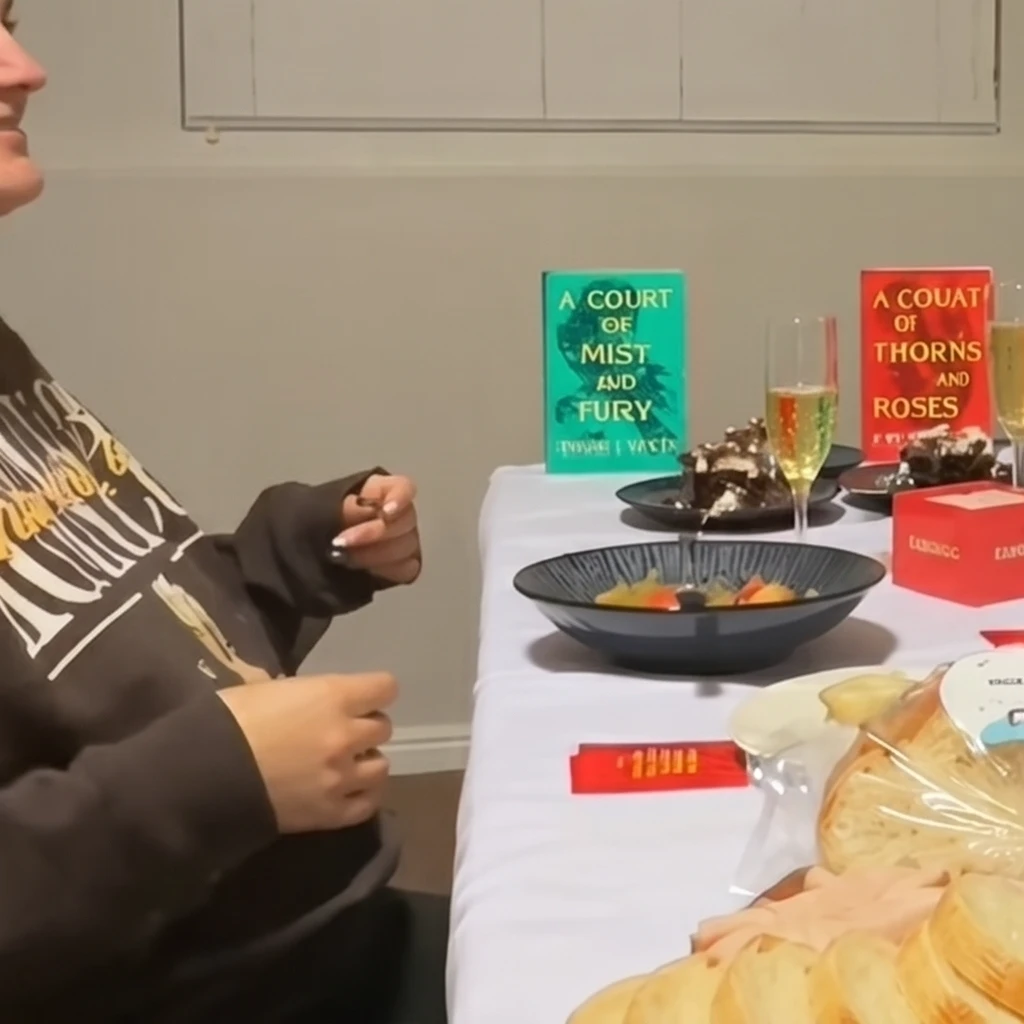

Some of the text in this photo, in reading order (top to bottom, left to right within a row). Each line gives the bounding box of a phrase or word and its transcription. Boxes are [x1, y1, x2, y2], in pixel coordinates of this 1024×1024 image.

[558, 288, 673, 310] A COURT
[873, 290, 890, 309] A
[894, 315, 918, 333] OF
[581, 343, 650, 365] MIST
[874, 340, 982, 363] THORNS
[597, 374, 636, 392] AND
[936, 371, 970, 387] AND
[578, 400, 652, 422] FURY
[873, 396, 959, 419] ROSES
